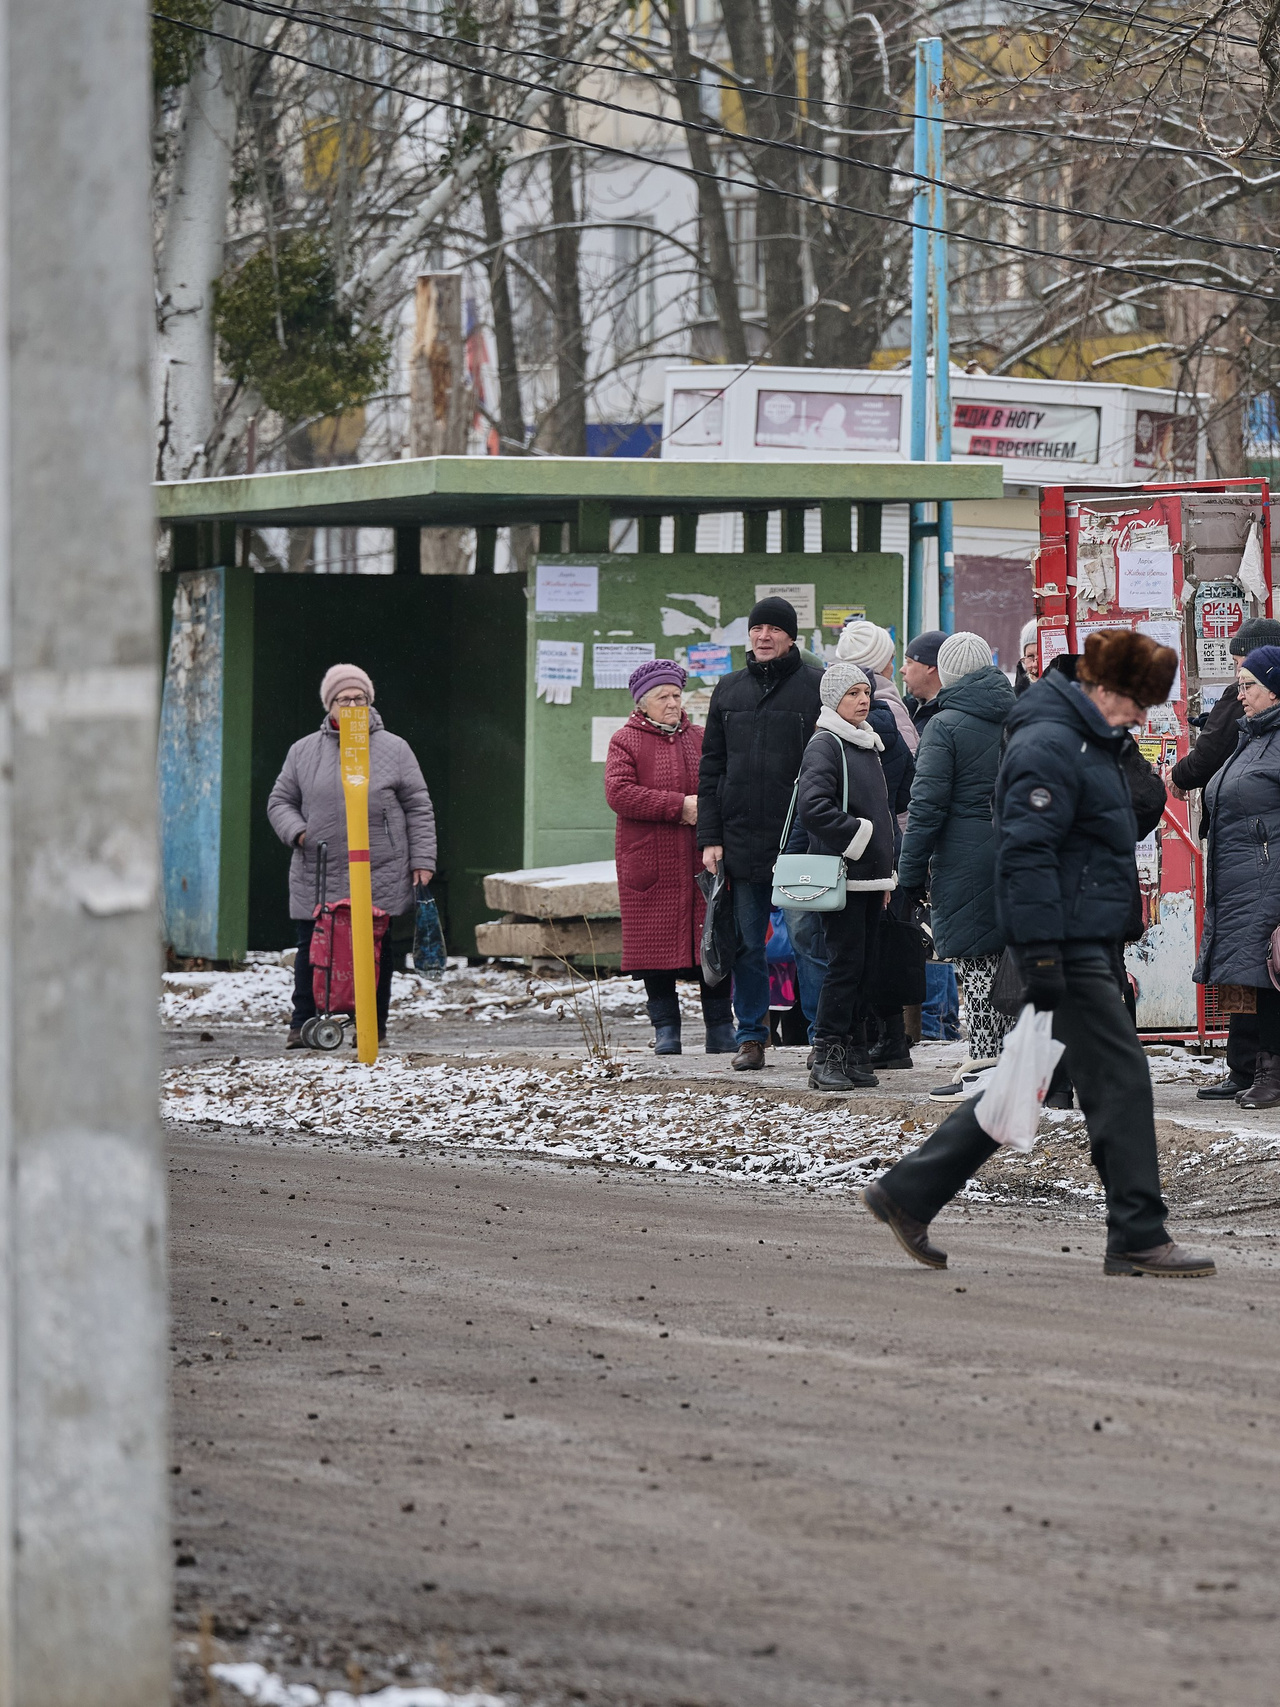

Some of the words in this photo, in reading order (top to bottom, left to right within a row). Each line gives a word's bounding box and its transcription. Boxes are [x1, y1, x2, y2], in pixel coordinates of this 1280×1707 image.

[992, 410, 1002, 428] В
[1006, 411, 1046, 430] НОГУ
[996, 440, 1077, 458] ВРЕМЕНЕМ
[1202, 602, 1241, 614] ОКНА
